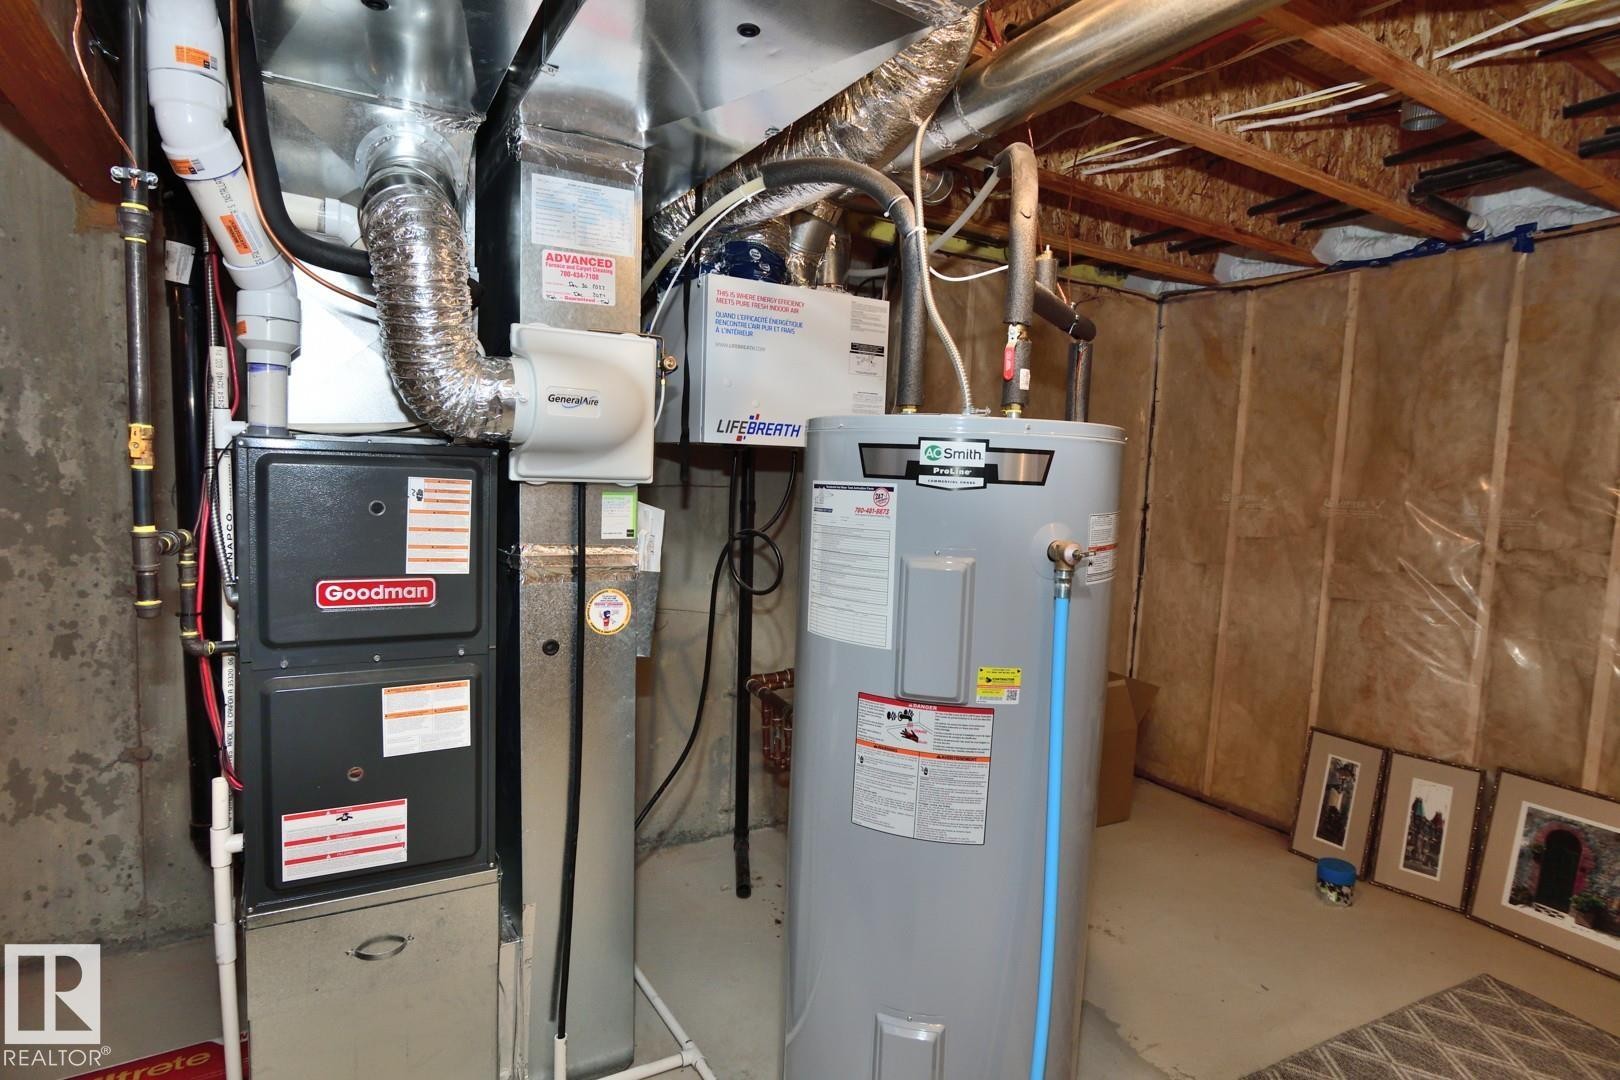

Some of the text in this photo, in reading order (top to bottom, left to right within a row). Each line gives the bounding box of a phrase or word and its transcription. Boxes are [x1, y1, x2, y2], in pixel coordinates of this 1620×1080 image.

[545, 252, 613, 268] ADVANCED
[716, 289, 729, 298] THIS
[736, 292, 757, 300] WHERE
[757, 294, 778, 304] ENERGY
[778, 297, 805, 308] EFFICIENCY
[716, 296, 734, 305] MEETS
[735, 299, 750, 307] PURE
[751, 302, 769, 310] FRESH
[769, 304, 789, 313] INDOOR
[715, 311, 736, 320] QUAND
[715, 318, 748, 329] RENCONTRE
[761, 324, 772, 332] PUR
[781, 327, 796, 335] FRAIS
[547, 393, 599, 406] GeneralAire
[716, 419, 801, 438] LIFEBREATH
[943, 447, 982, 460] Smith
[225, 513, 233, 560] NAPCO
[325, 584, 428, 601] Goodman
